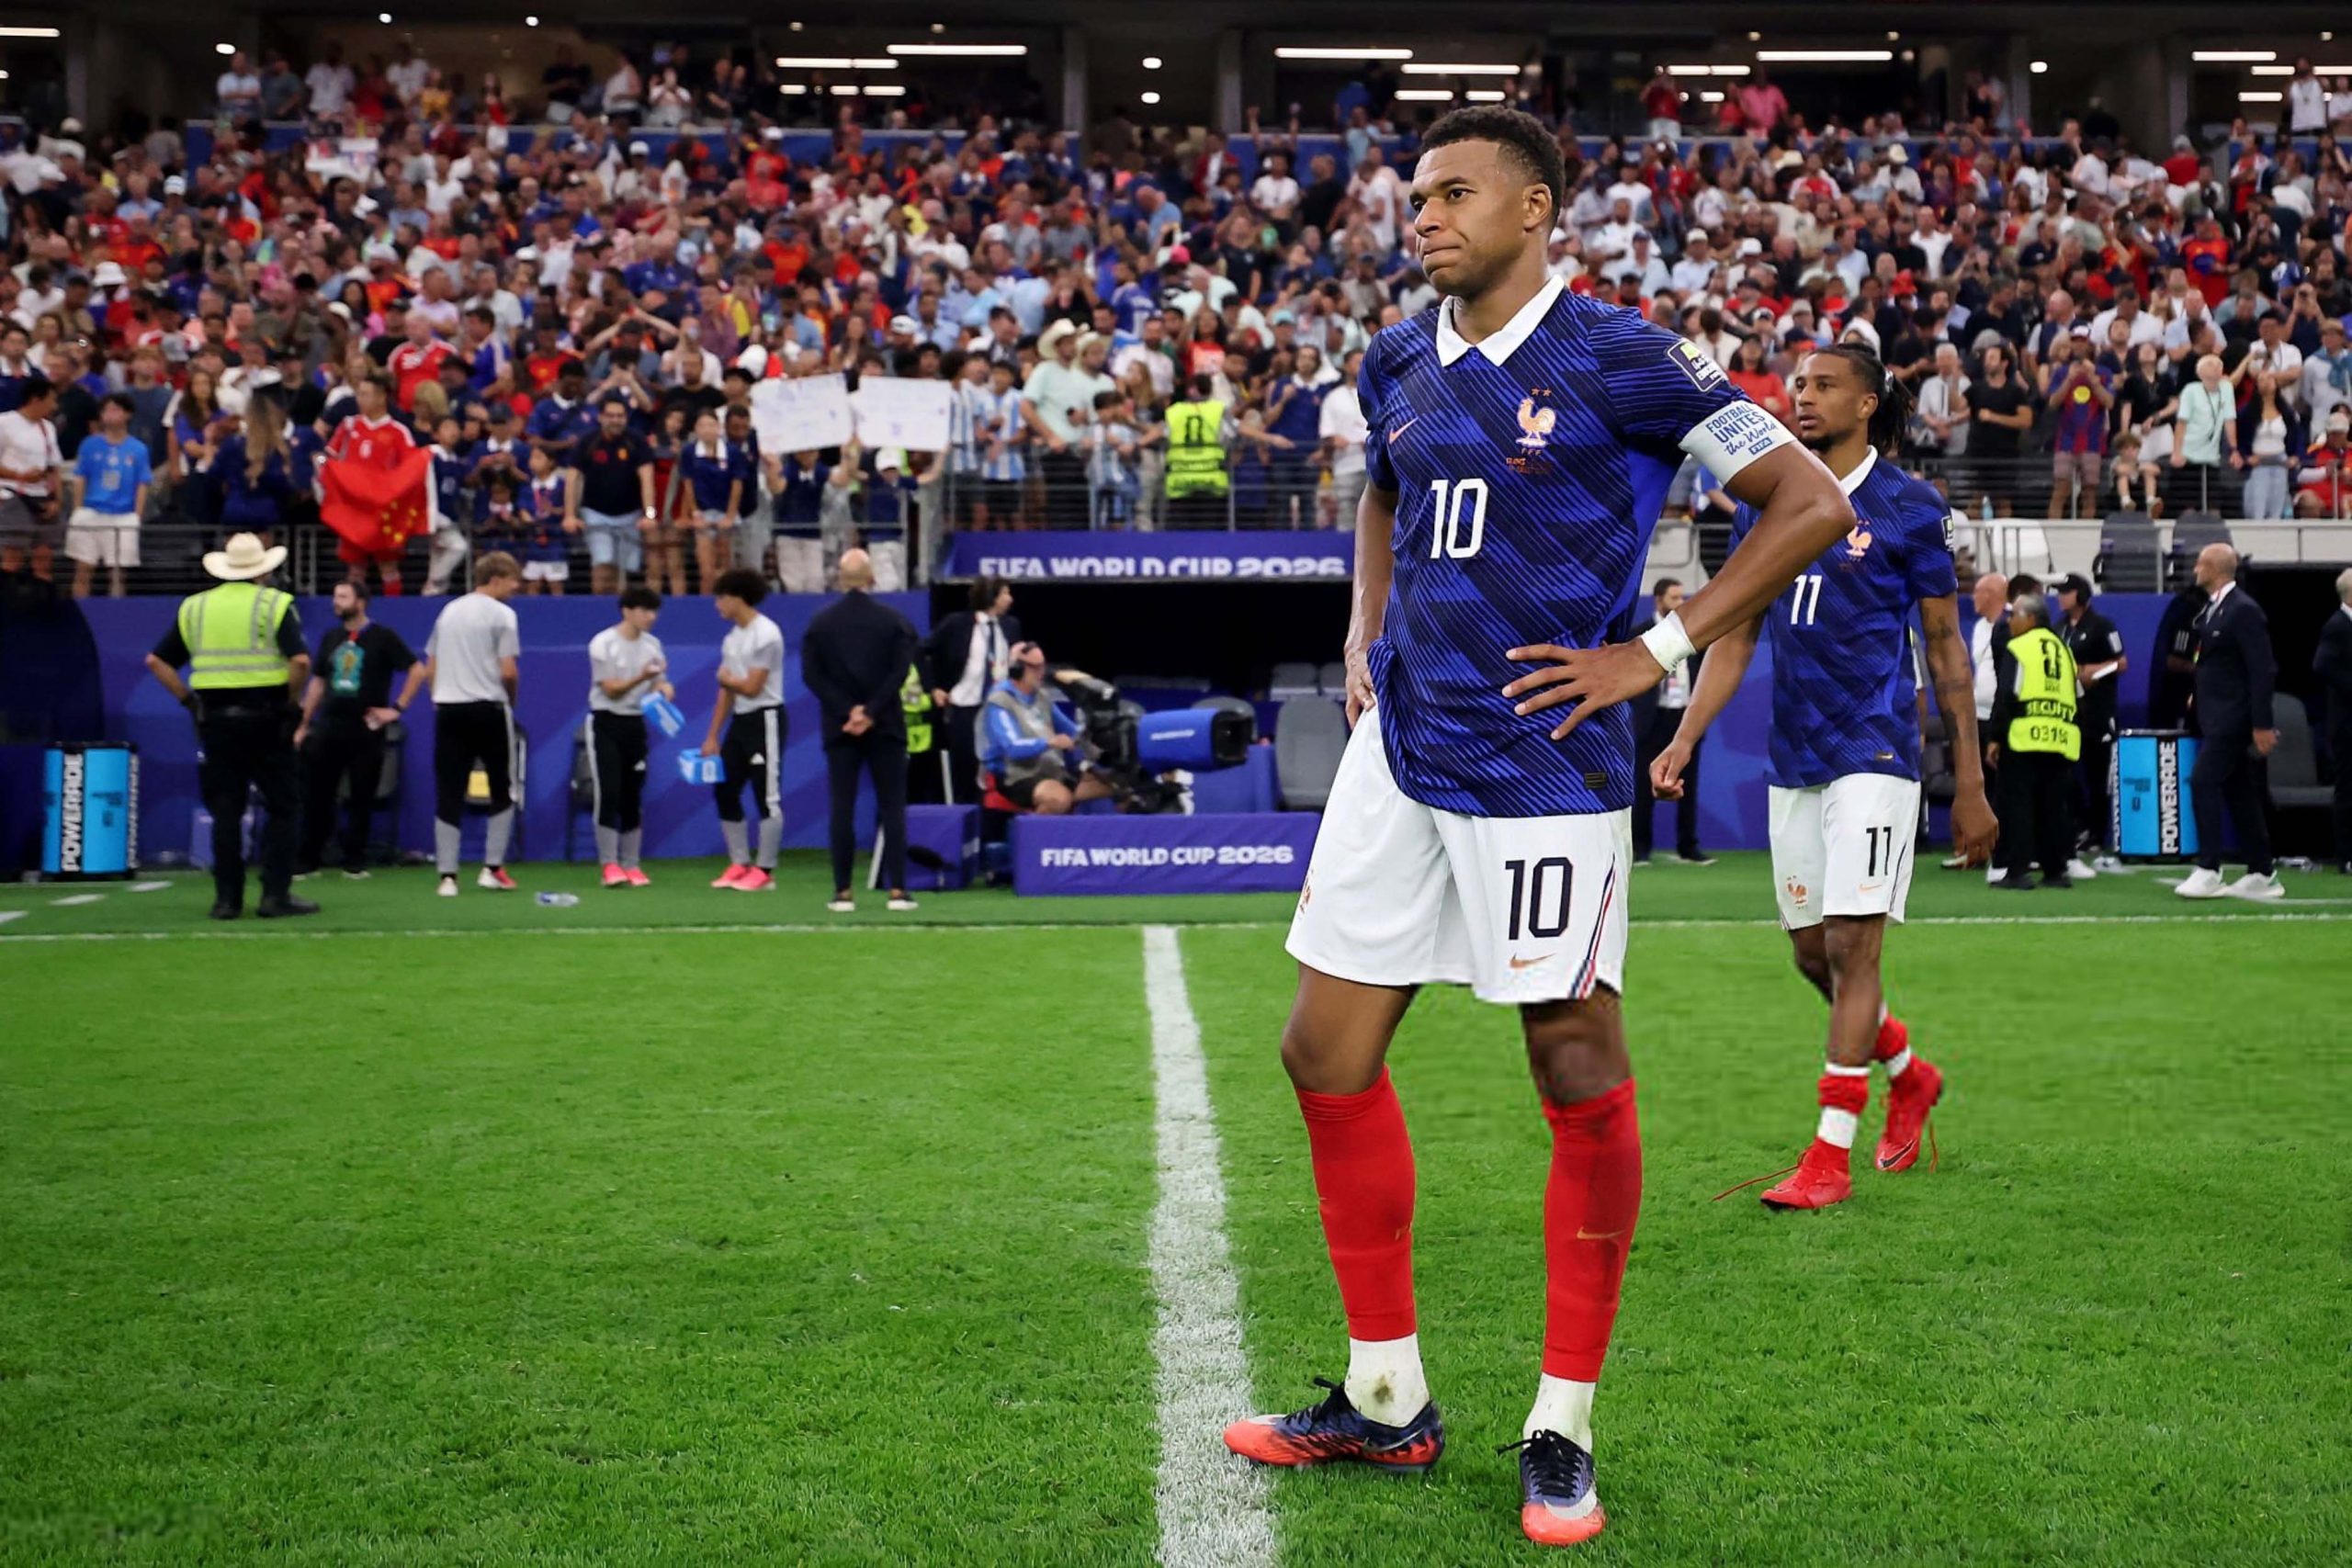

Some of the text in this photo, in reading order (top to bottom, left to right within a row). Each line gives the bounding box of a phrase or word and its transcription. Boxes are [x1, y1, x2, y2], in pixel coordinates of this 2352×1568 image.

[1705, 404, 1753, 433] FOOTBALL
[1713, 412, 1765, 443] UNITES
[1724, 421, 1778, 455] the World
[1430, 478, 1488, 558] 10
[979, 557, 1046, 578] FIFA
[1237, 557, 1346, 577] 2026
[1791, 574, 1823, 626] 11
[2159, 741, 2179, 854] POWERADE
[1041, 845, 1294, 866] FIFA WORLD CUP 2026
[1866, 827, 1892, 877] 11
[1505, 856, 1574, 941] 10
